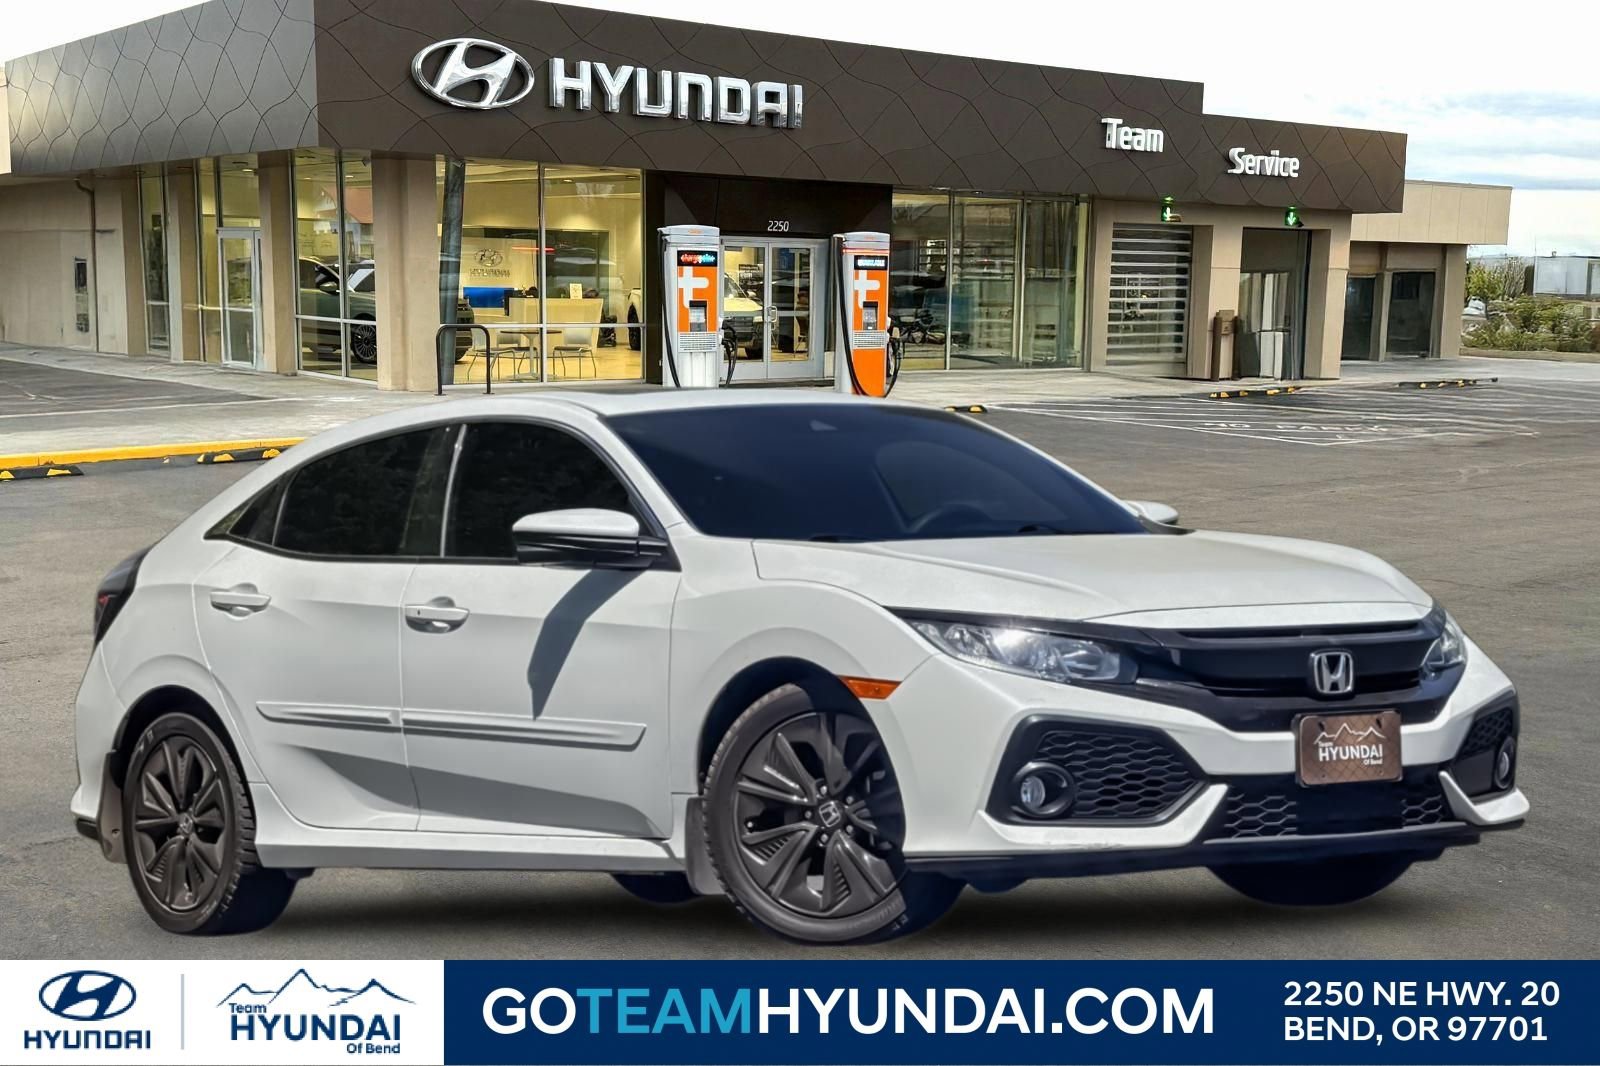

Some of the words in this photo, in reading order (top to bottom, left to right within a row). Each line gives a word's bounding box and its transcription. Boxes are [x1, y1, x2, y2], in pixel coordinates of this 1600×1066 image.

[549, 57, 803, 129] HYUNDAI
[1101, 117, 1165, 153] Team
[1227, 147, 1300, 178] Service
[767, 220, 790, 232] 2250
[1318, 744, 1384, 762] HYUNDAI
